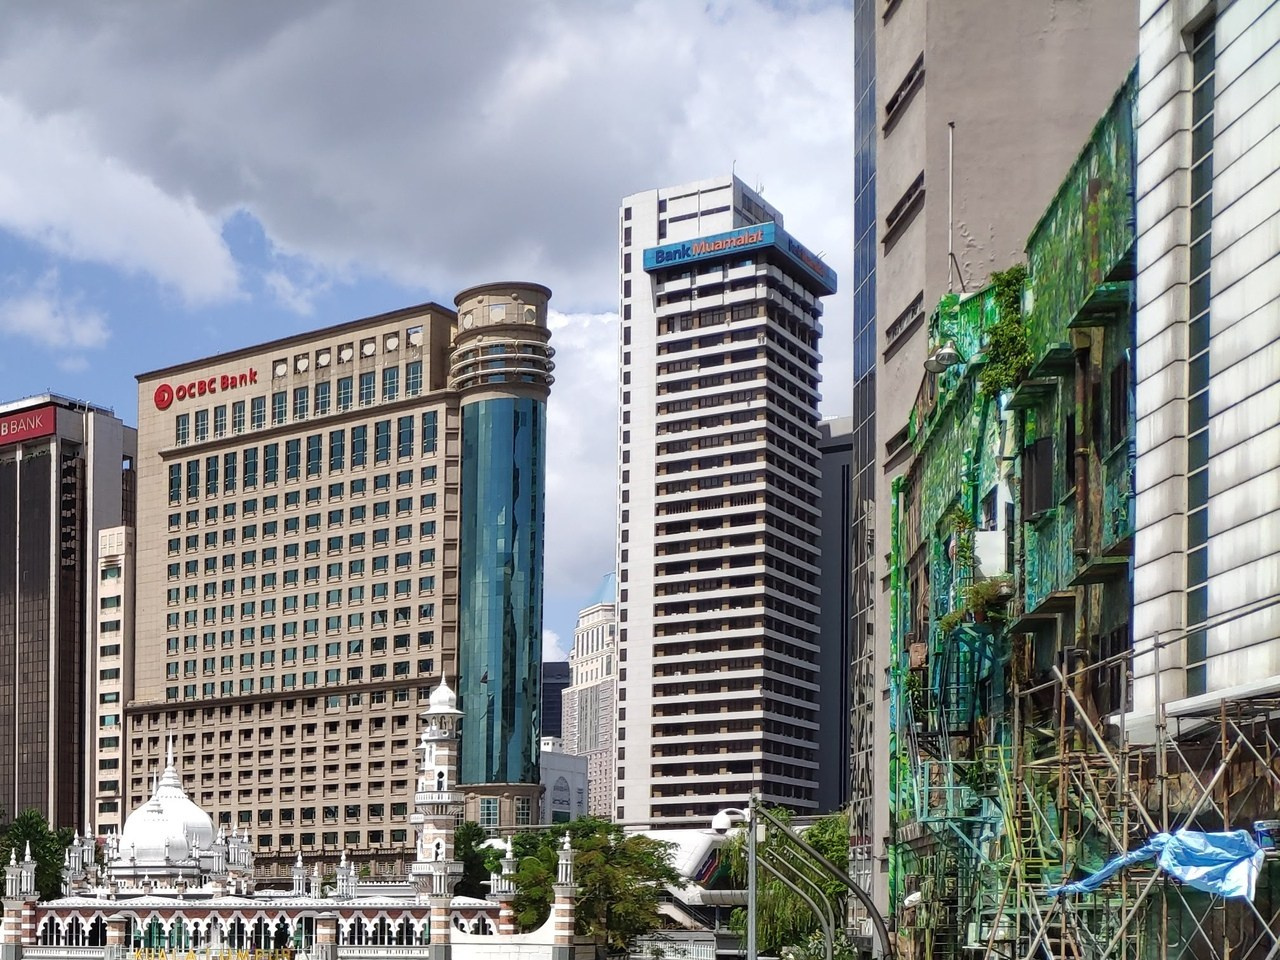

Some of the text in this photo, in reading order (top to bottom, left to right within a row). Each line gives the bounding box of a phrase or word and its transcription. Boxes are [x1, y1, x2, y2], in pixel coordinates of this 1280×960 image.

[655, 245, 691, 265] Bank
[692, 229, 764, 257] Muamalat
[175, 367, 258, 400] OCBC Bank
[10, 414, 43, 436] BANK
